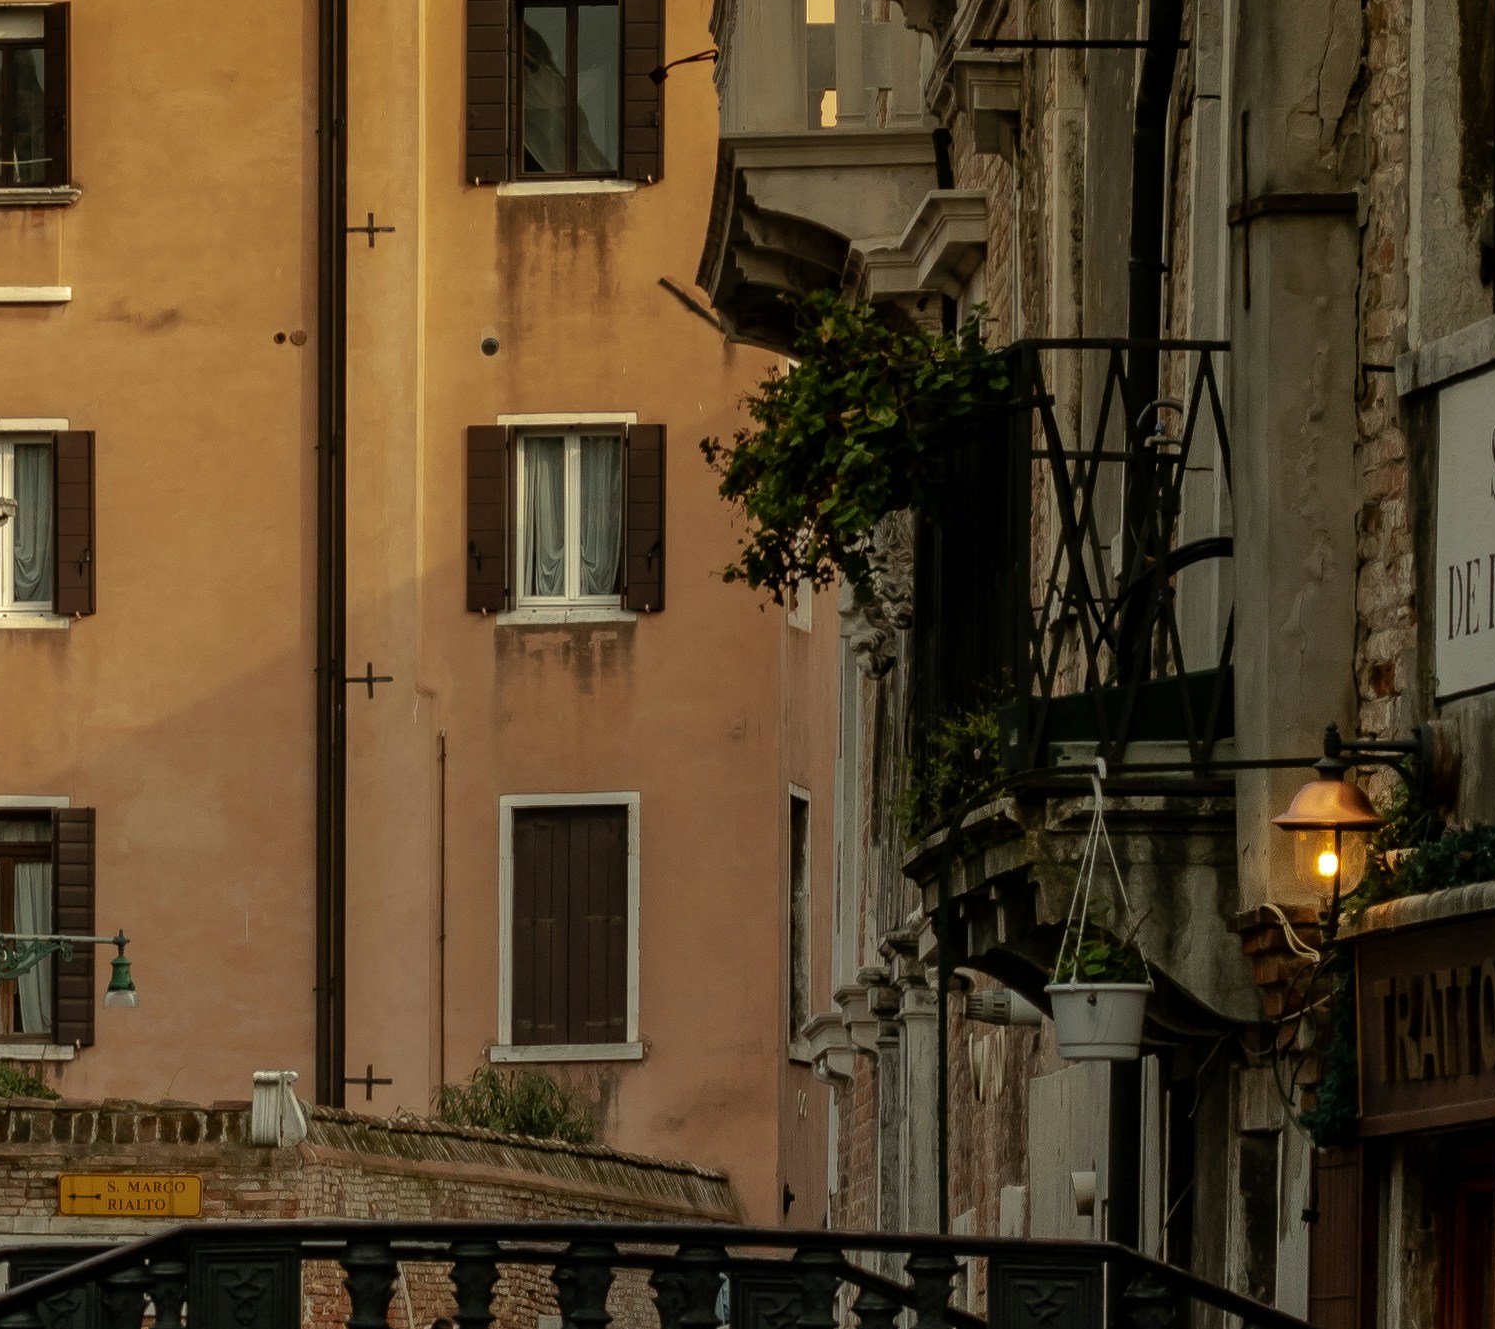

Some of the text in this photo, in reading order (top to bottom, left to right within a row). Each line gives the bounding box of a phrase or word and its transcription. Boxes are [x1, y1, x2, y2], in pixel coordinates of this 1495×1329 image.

[1448, 558, 1481, 641] DE
[107, 1180, 186, 1194] S. MARCO
[107, 1198, 166, 1211] RIALTO
